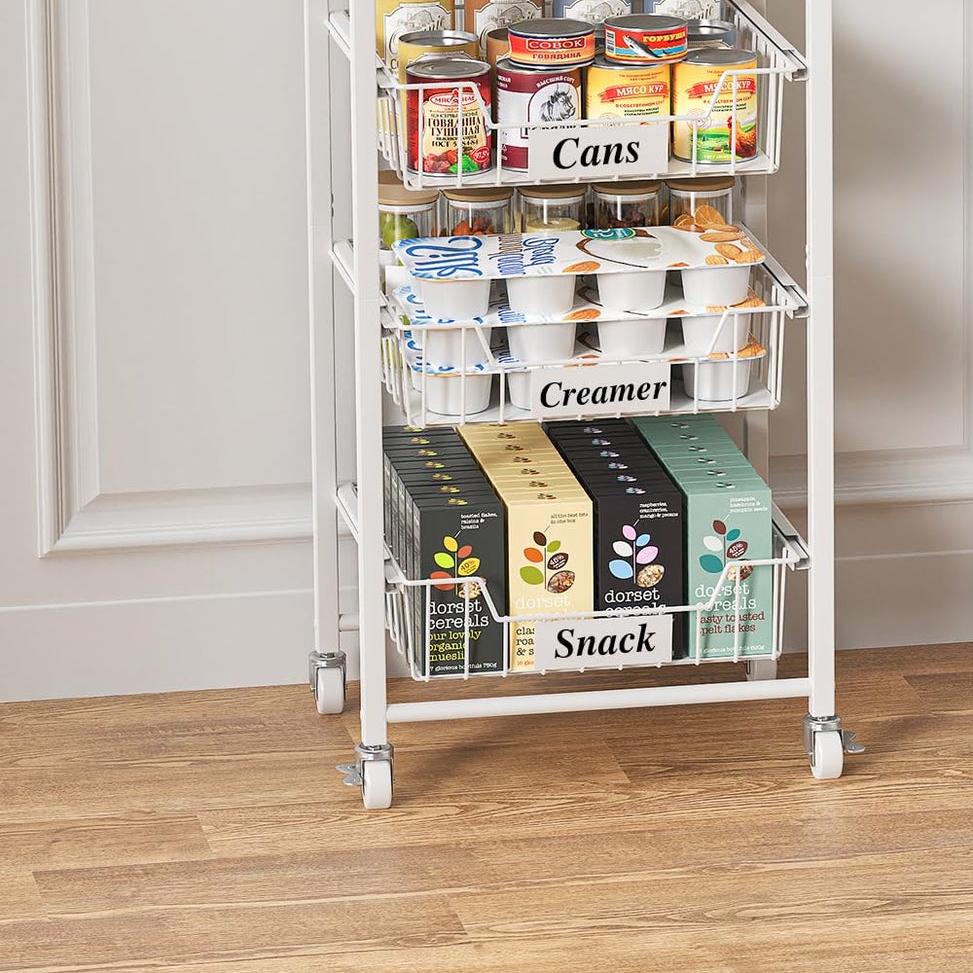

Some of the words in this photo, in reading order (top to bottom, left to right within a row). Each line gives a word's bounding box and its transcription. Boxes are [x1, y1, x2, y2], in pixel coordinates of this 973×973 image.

[528, 38, 583, 50] СОВОК
[616, 86, 647, 97] МЯСО
[650, 84, 664, 95] КУР
[552, 137, 640, 169] Cans
[540, 378, 667, 409] Creamer
[515, 594, 570, 610] dorset
[604, 587, 660, 603] dorset
[429, 599, 482, 615] dorset
[429, 614, 489, 629] cereals
[696, 613, 723, 624] asty
[449, 629, 482, 641] lovly
[697, 624, 723, 636] pelt
[555, 623, 656, 659] Snack
